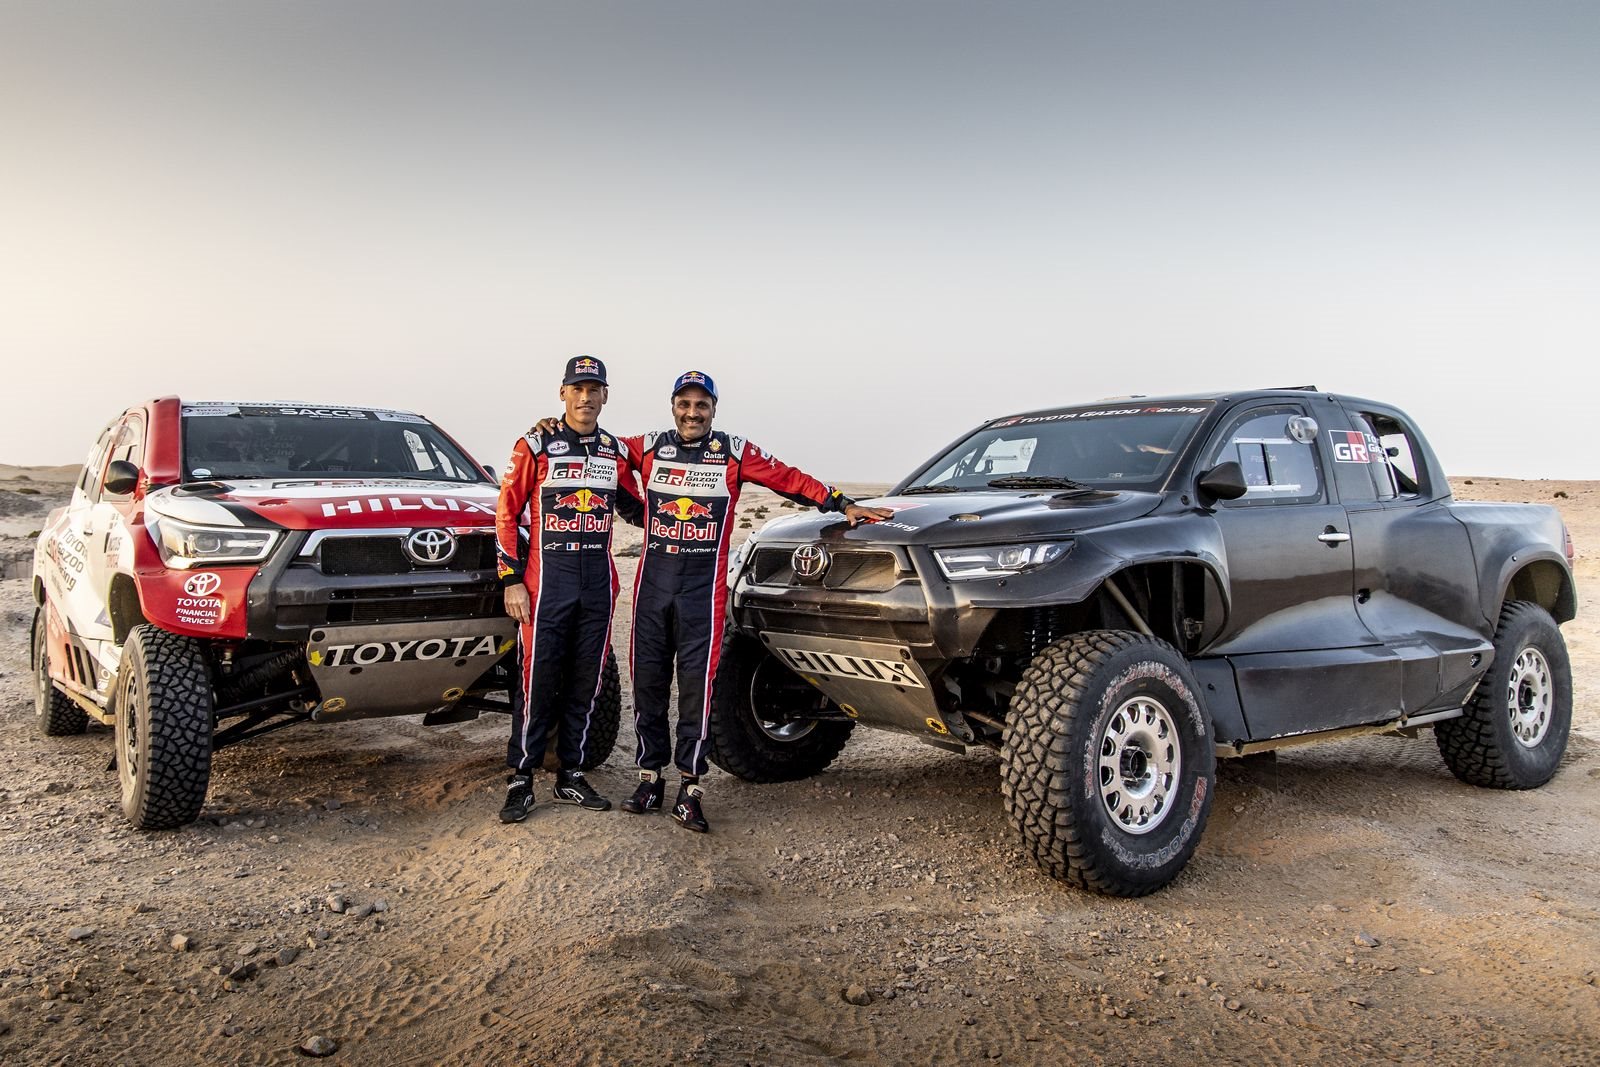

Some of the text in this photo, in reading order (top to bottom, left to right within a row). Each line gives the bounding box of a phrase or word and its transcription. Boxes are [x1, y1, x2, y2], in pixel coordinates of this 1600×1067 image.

[279, 408, 367, 417] SACCS
[1019, 413, 1078, 424] TOYOTA
[1079, 408, 1140, 418] GAZOO
[1142, 406, 1207, 414] Racing
[598, 445, 616, 455] Qatar
[703, 451, 726, 459] Qatar
[1334, 443, 1368, 461] GR
[589, 462, 616, 471] TOYOTA
[553, 468, 582, 479] GR
[583, 474, 612, 482] Racing
[654, 473, 683, 486] GR
[321, 497, 497, 517] HILUX
[545, 512, 612, 533] Red Bull
[651, 516, 718, 541] Red Bull
[176, 597, 222, 608] TOYOTA
[175, 607, 219, 617] FINANCIAL
[327, 635, 497, 667] TOYOTA
[780, 649, 920, 685] HILUX
